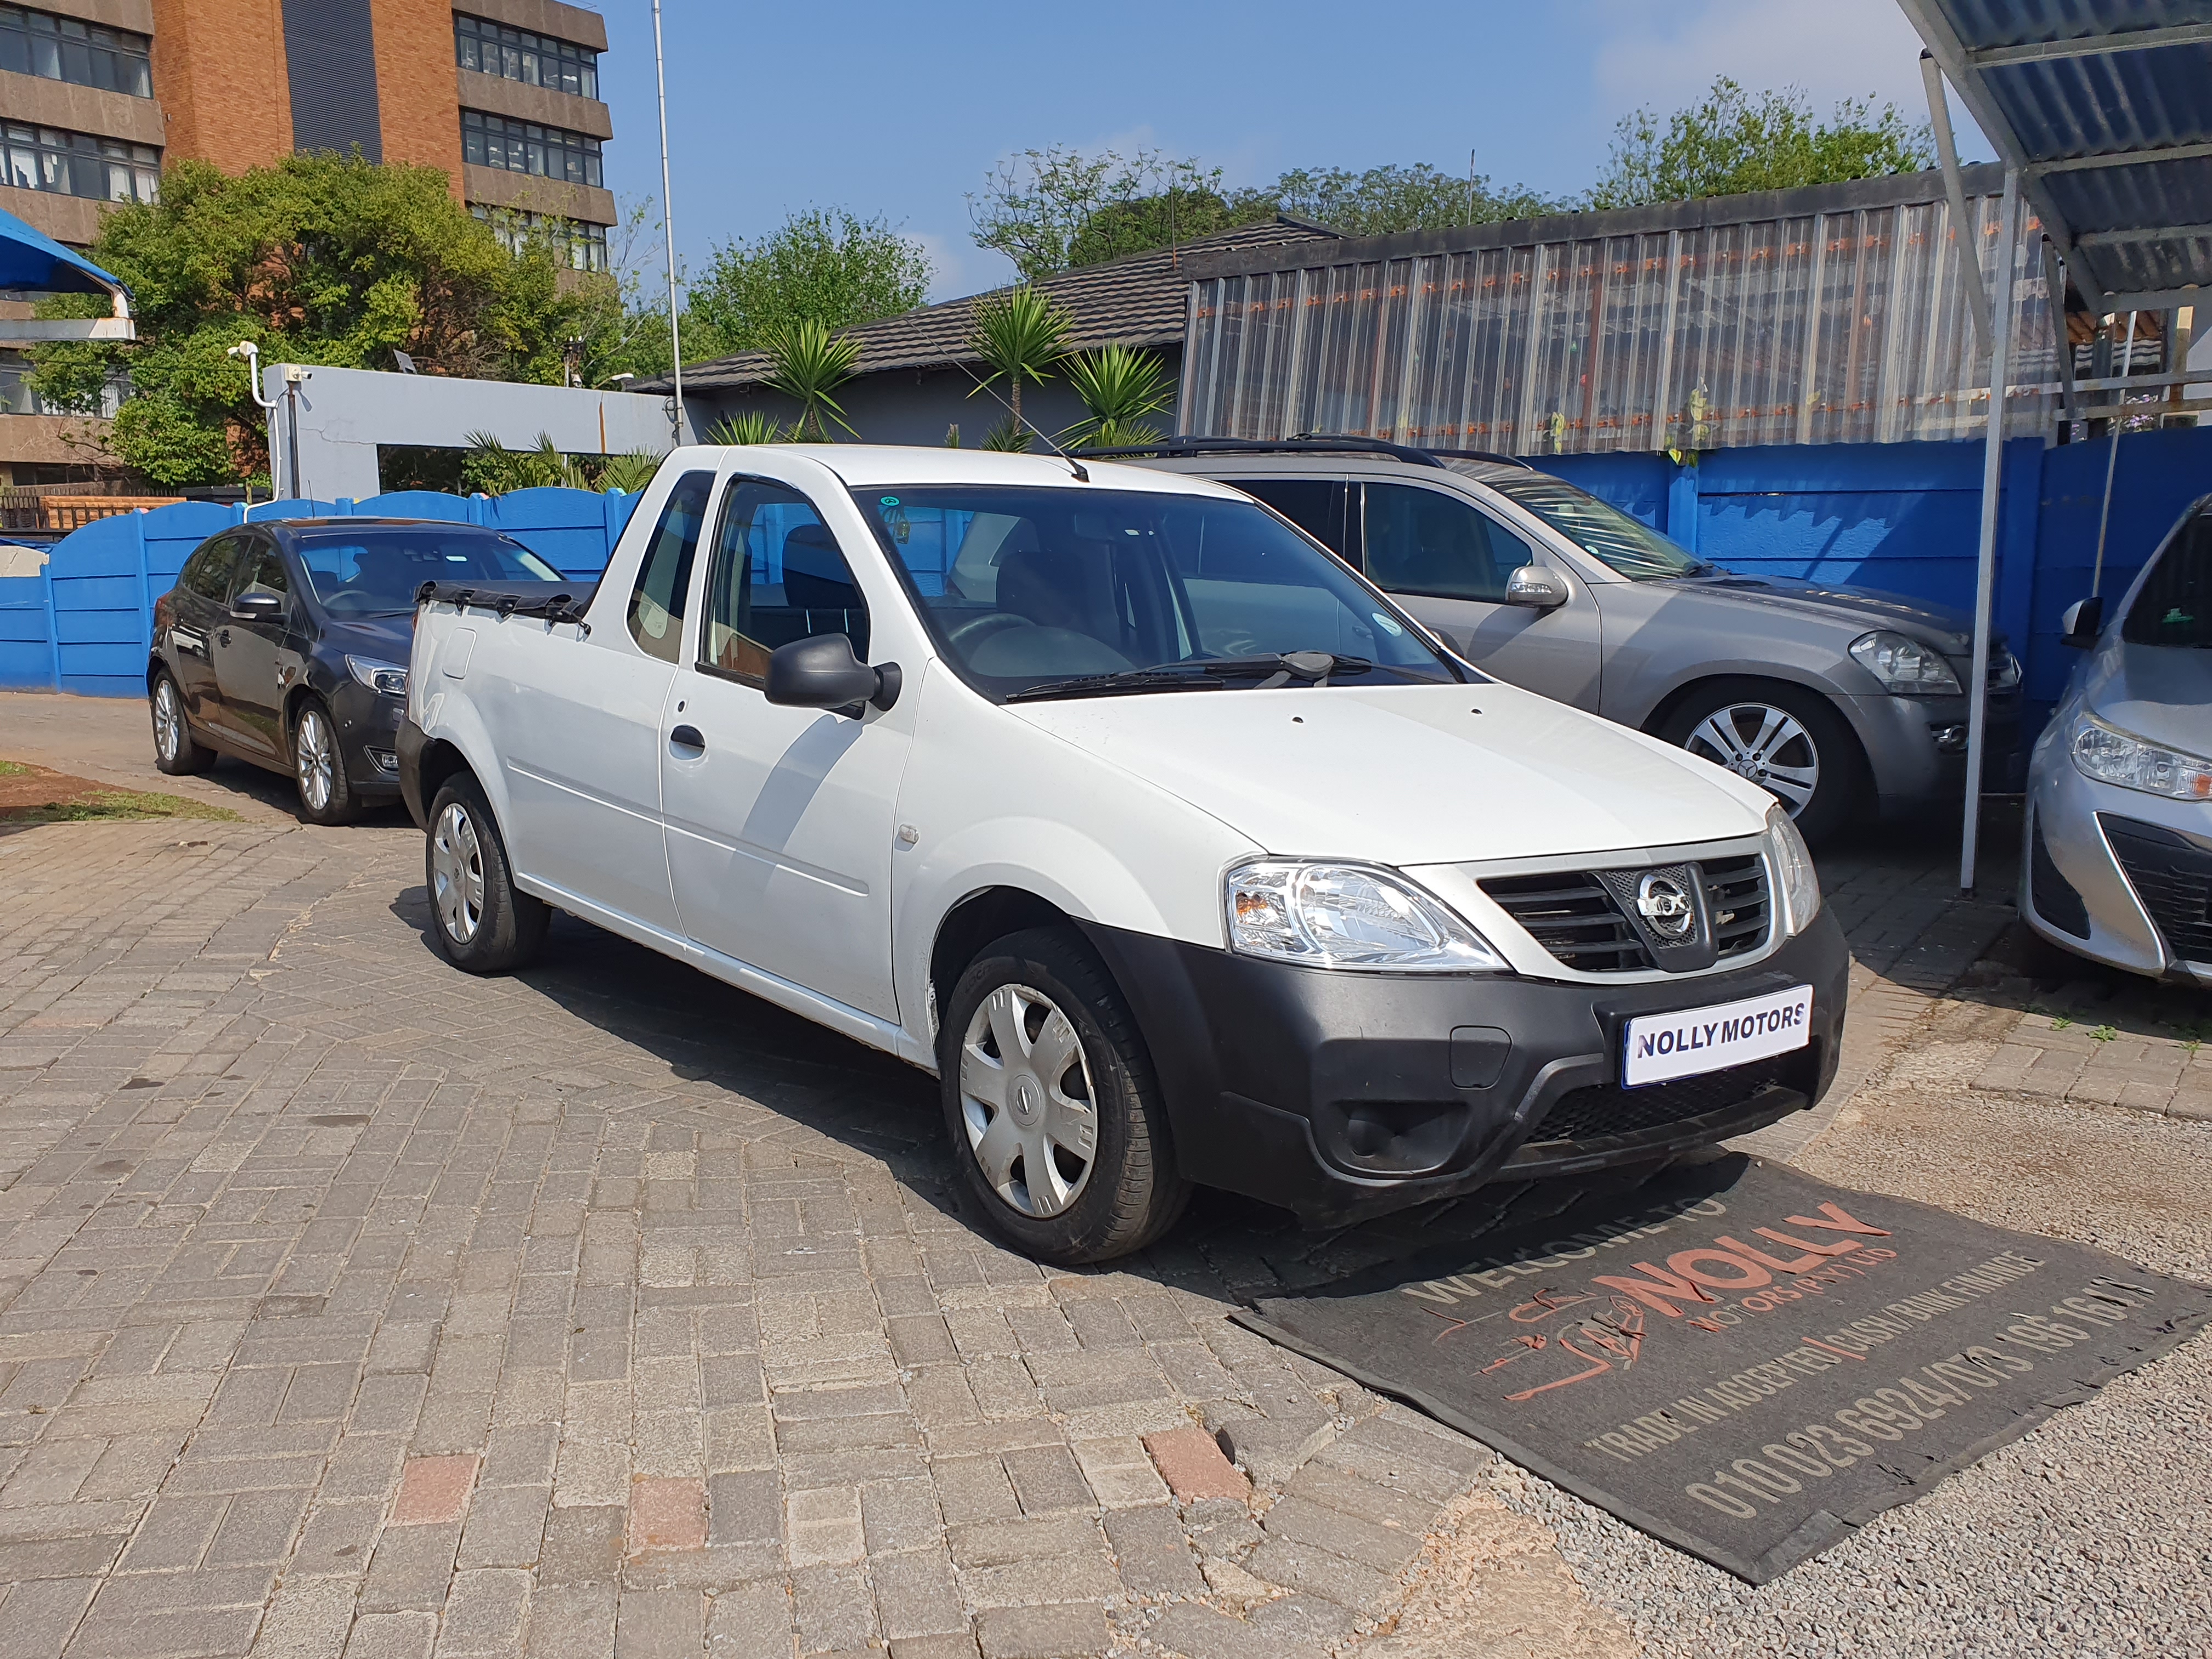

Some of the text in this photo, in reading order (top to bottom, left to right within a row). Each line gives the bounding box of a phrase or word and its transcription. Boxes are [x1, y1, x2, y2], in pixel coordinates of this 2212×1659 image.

[1637, 1003, 1805, 1059] NOLLY MOTORS
[1400, 1197, 1726, 1304] WELCOME TO
[1591, 1200, 1893, 1317] NOLLY
[1583, 1407, 1699, 1463] TRADE
[1670, 1396, 1729, 1424] IN
[1703, 1346, 1842, 1411] ACCEPTED
[1940, 1250, 2046, 1298] FINANCE
[1685, 1286, 1803, 1333] MOTORS
